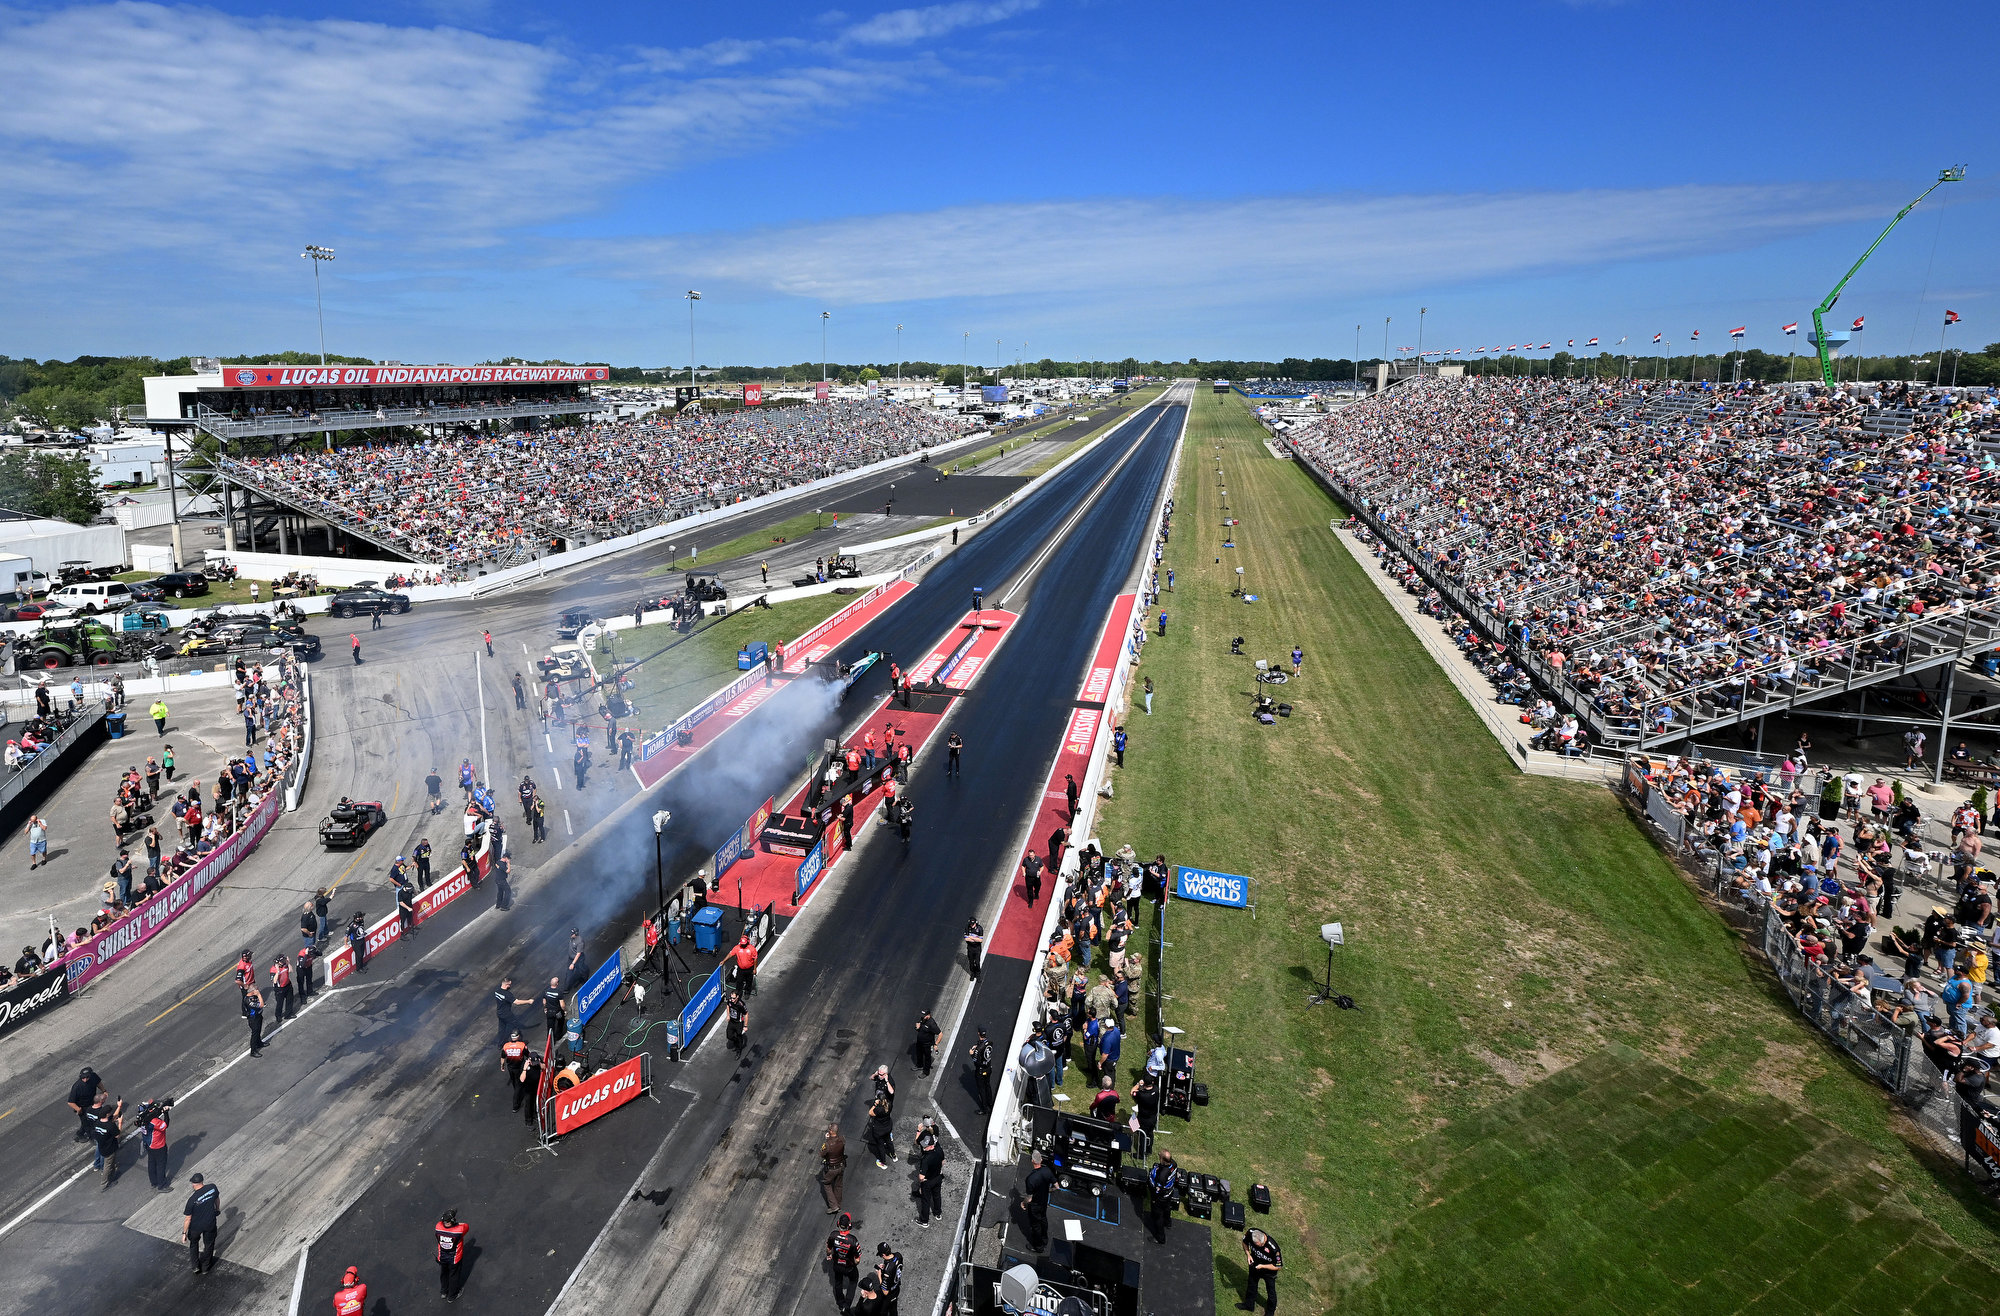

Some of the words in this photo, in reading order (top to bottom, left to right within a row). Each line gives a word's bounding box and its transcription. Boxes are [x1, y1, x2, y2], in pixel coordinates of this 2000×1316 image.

[280, 369, 340, 385] LUCAS
[344, 369, 371, 383] OIL
[376, 369, 492, 383] INDIANAPOLIS
[494, 369, 557, 381] RACEWAY
[557, 369, 587, 380] PARK
[725, 686, 737, 702] U.S.
[737, 663, 767, 694] NATIONAL
[1087, 667, 1112, 693] MISSION
[1070, 709, 1099, 743] MISSION
[647, 737, 665, 757] HOME
[666, 731, 675, 743] OF
[718, 834, 740, 862] CAMPING
[718, 844, 740, 873] WORLD
[800, 848, 820, 878] CAMPING
[801, 859, 820, 889] WORLD
[433, 874, 471, 909] MISSIO
[1184, 872, 1241, 890] CAMPING
[1184, 881, 1240, 902] WORLD
[97, 915, 142, 965] SHIRLEY
[193, 841, 237, 895] MULDOWNEY
[561, 1084, 610, 1120] LUCAS
[613, 1072, 636, 1094] OIL
